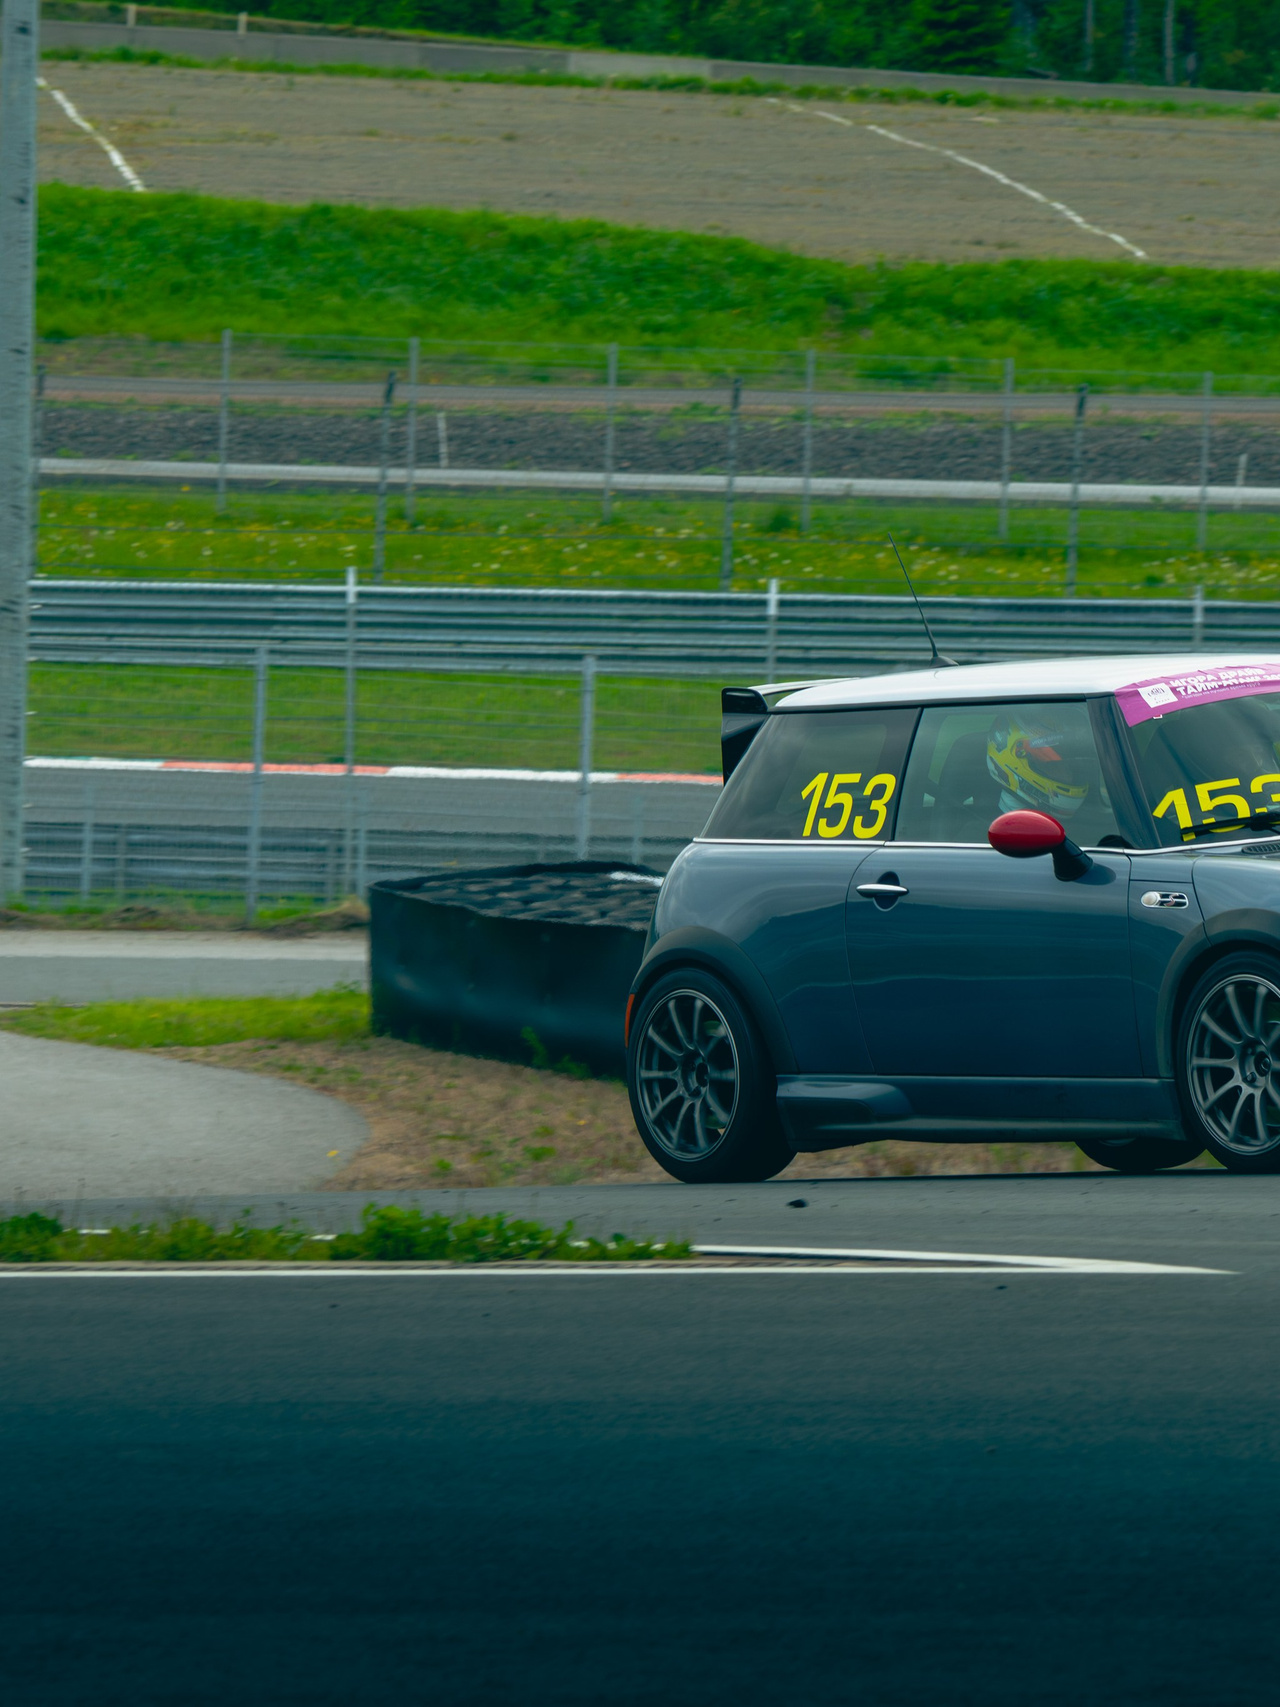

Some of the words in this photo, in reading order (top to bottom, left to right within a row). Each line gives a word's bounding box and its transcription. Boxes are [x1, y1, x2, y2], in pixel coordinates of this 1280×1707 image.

[1169, 674, 1217, 687] ИГОРА
[1219, 668, 1266, 680] ДРАЙВ
[802, 773, 896, 838] 153
